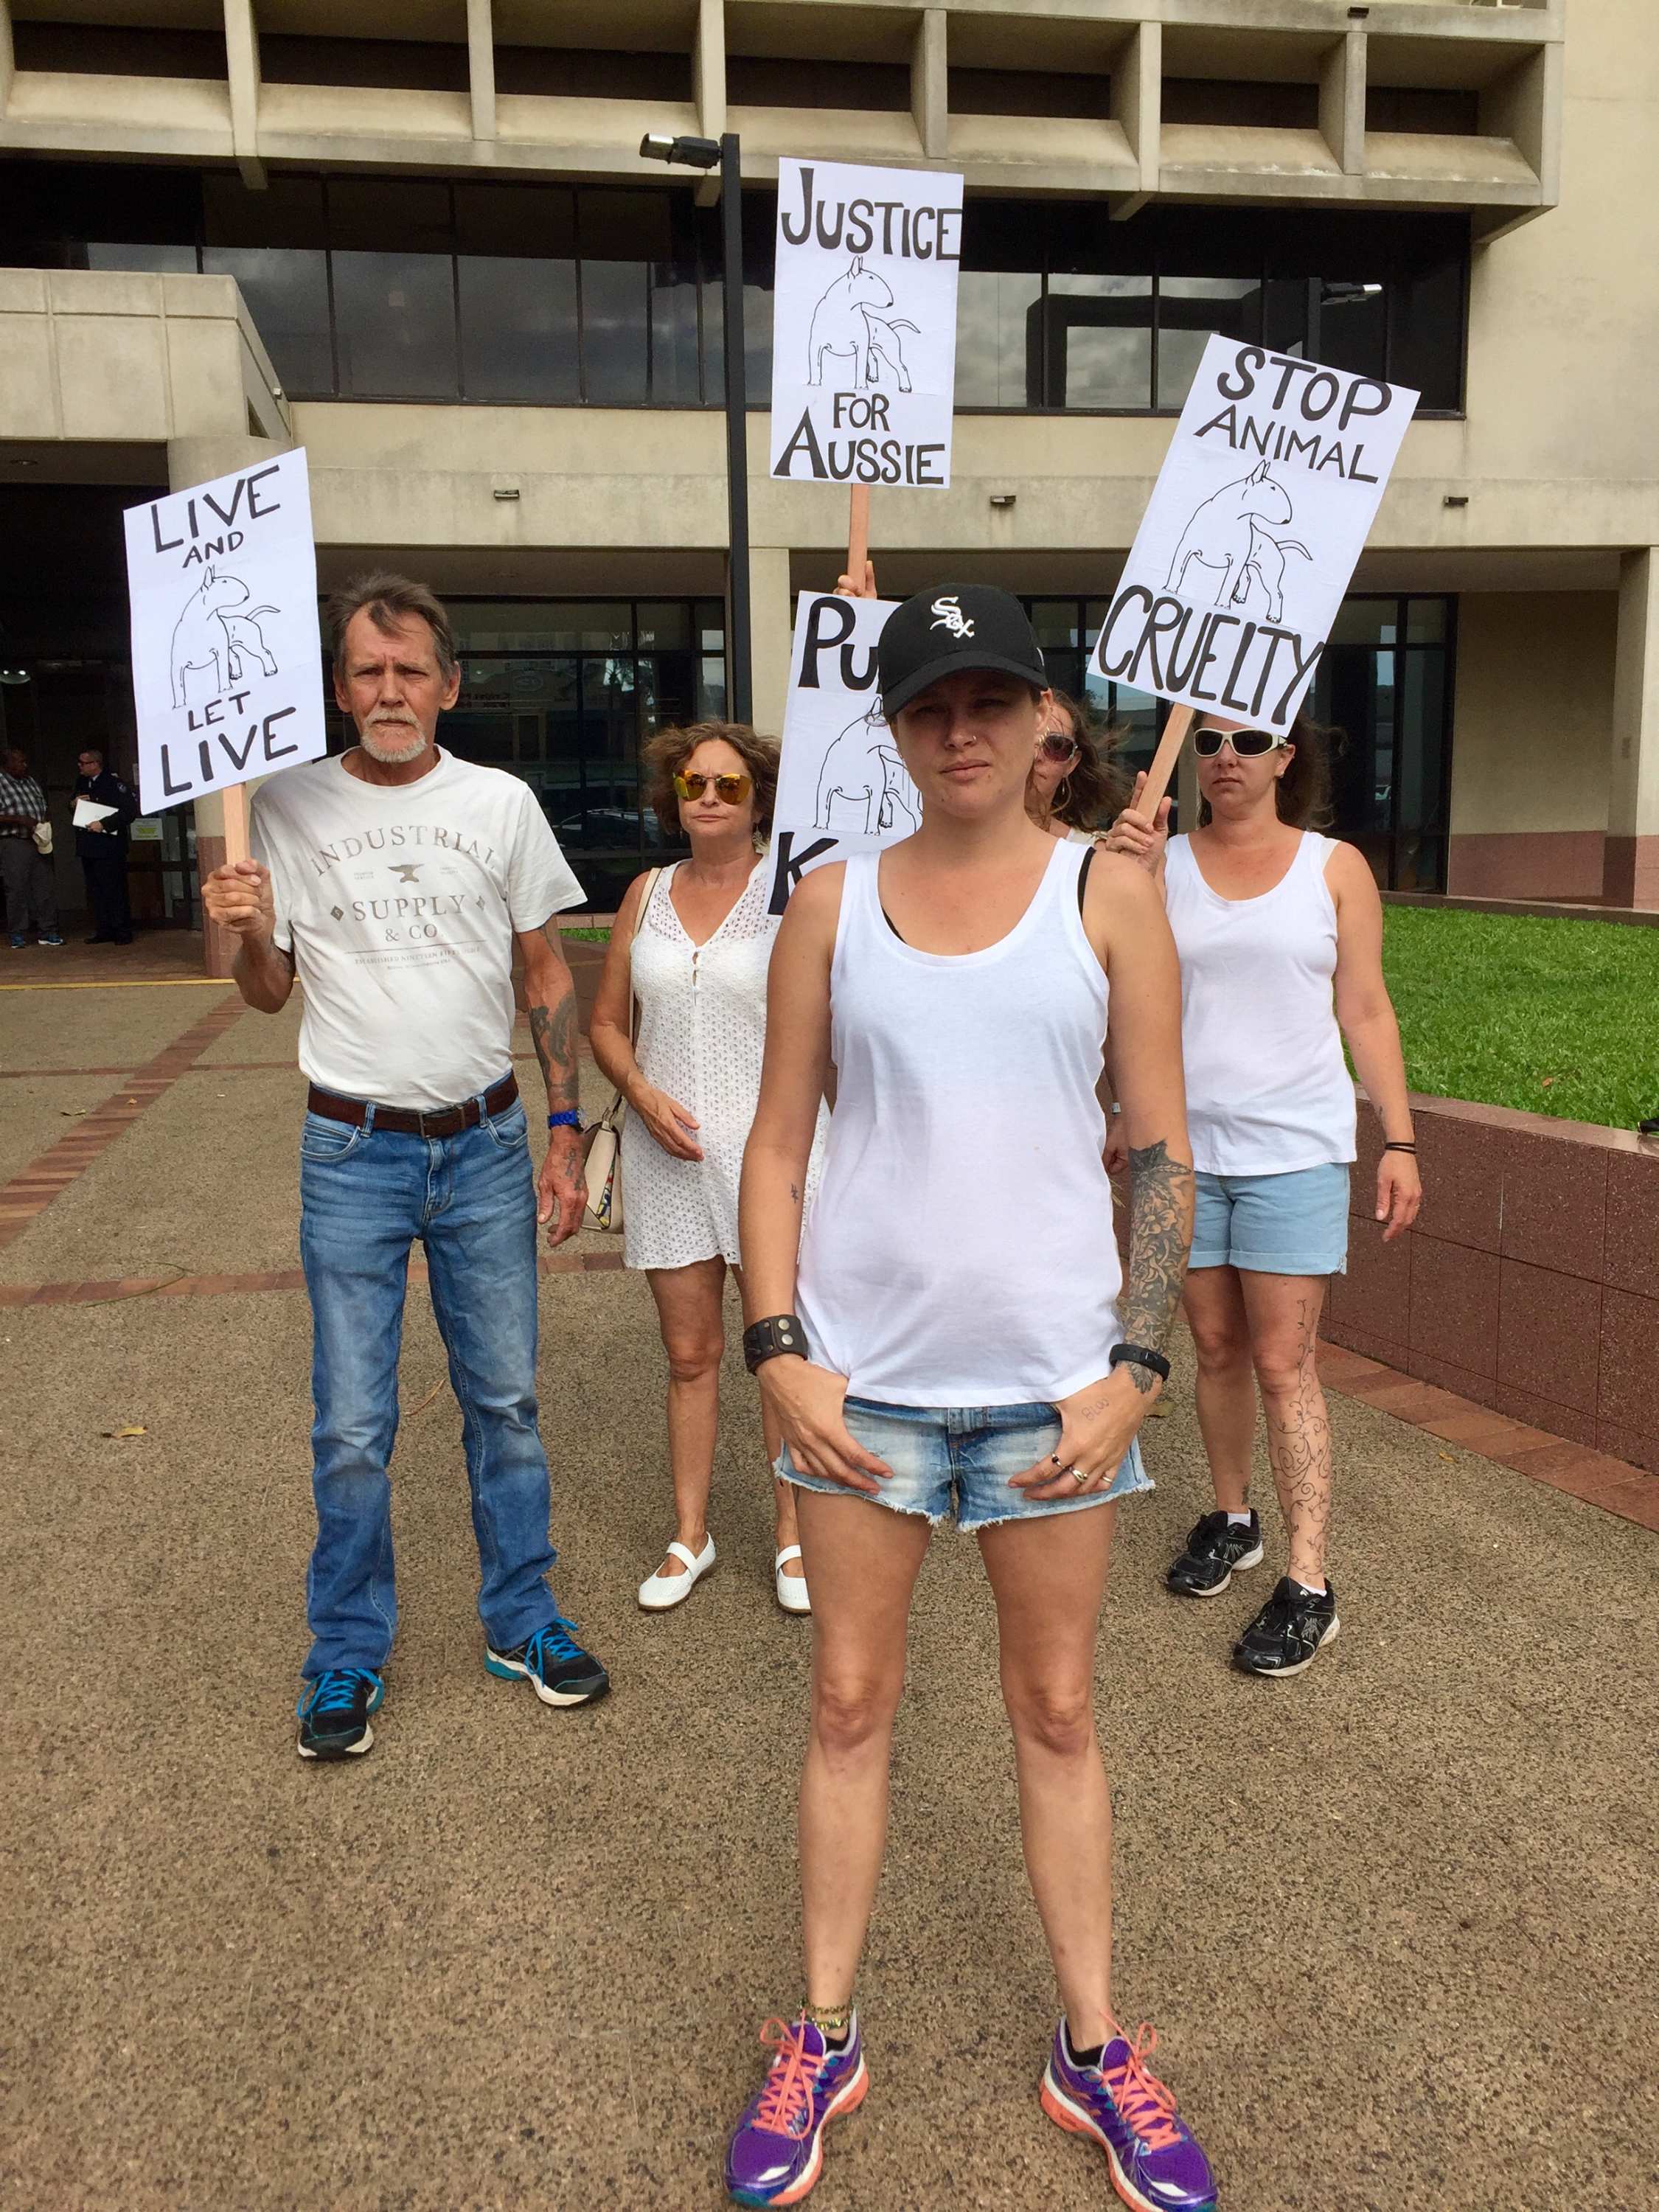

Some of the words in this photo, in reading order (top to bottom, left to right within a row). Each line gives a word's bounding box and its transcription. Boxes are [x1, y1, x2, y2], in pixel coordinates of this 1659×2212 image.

[782, 167, 962, 261] JUSTICE
[833, 392, 890, 431] FOR
[1217, 346, 1391, 431] STOP
[773, 406, 945, 484] AUSSIE
[1193, 404, 1378, 484] ANIMAL
[151, 465, 281, 553] LIVE
[182, 531, 244, 568] AND
[798, 597, 883, 695] PU
[1098, 585, 1326, 726] CRUELTY
[188, 691, 251, 731] LET
[161, 706, 299, 797] LIVE
[352, 894, 466, 922] SUPPLY
[385, 928, 399, 942] &
